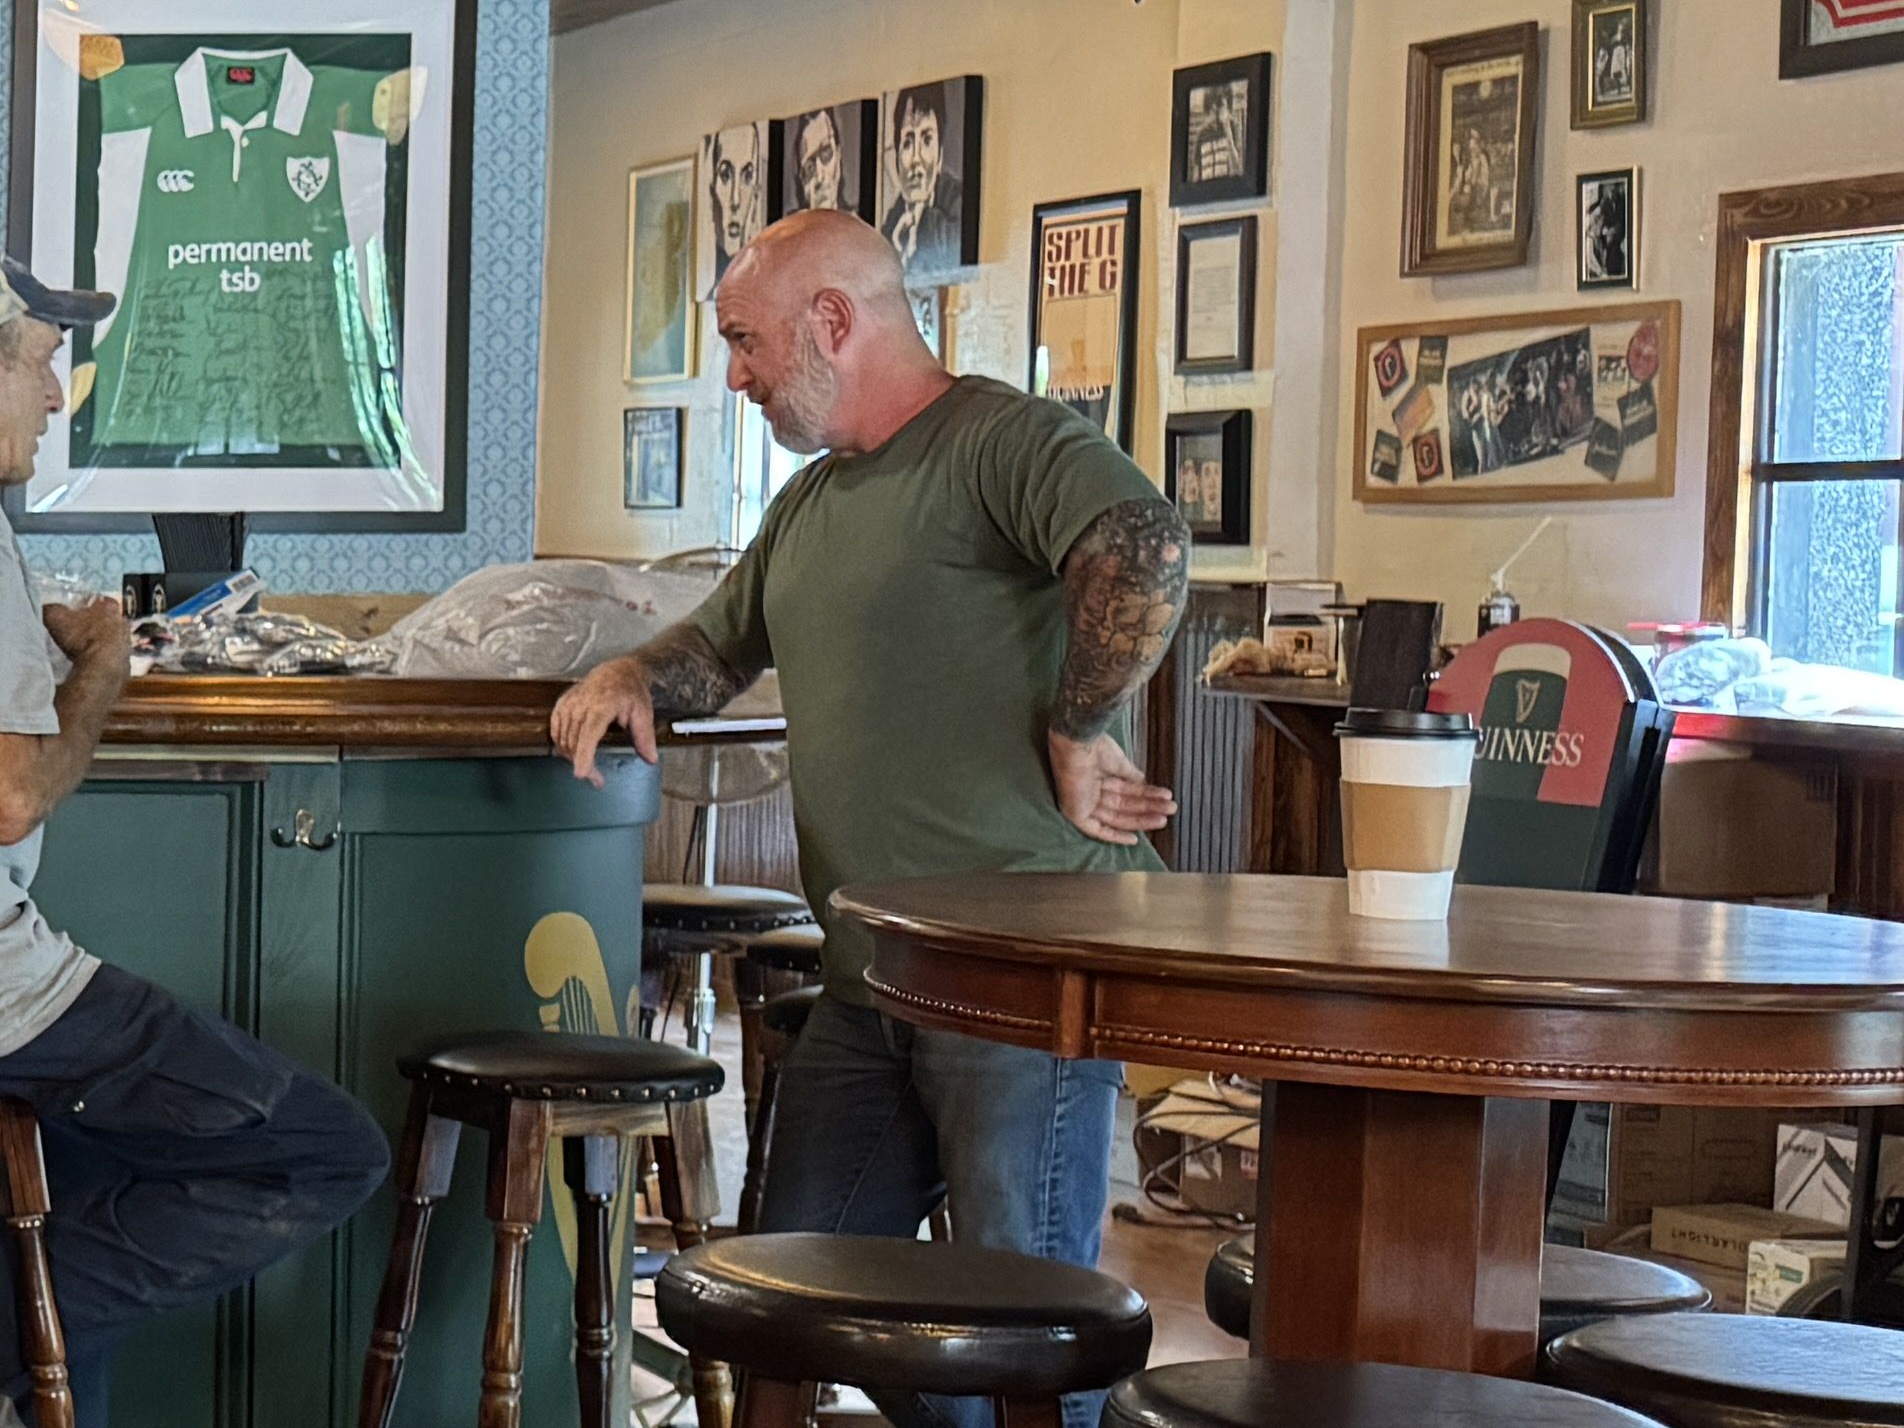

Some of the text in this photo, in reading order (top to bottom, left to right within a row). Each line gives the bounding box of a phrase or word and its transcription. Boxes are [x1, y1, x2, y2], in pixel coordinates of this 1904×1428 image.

[168, 238, 313, 269] permanent
[1047, 224, 1120, 263] SPLIT
[220, 265, 262, 293] tsb
[1047, 259, 1118, 297] THE G
